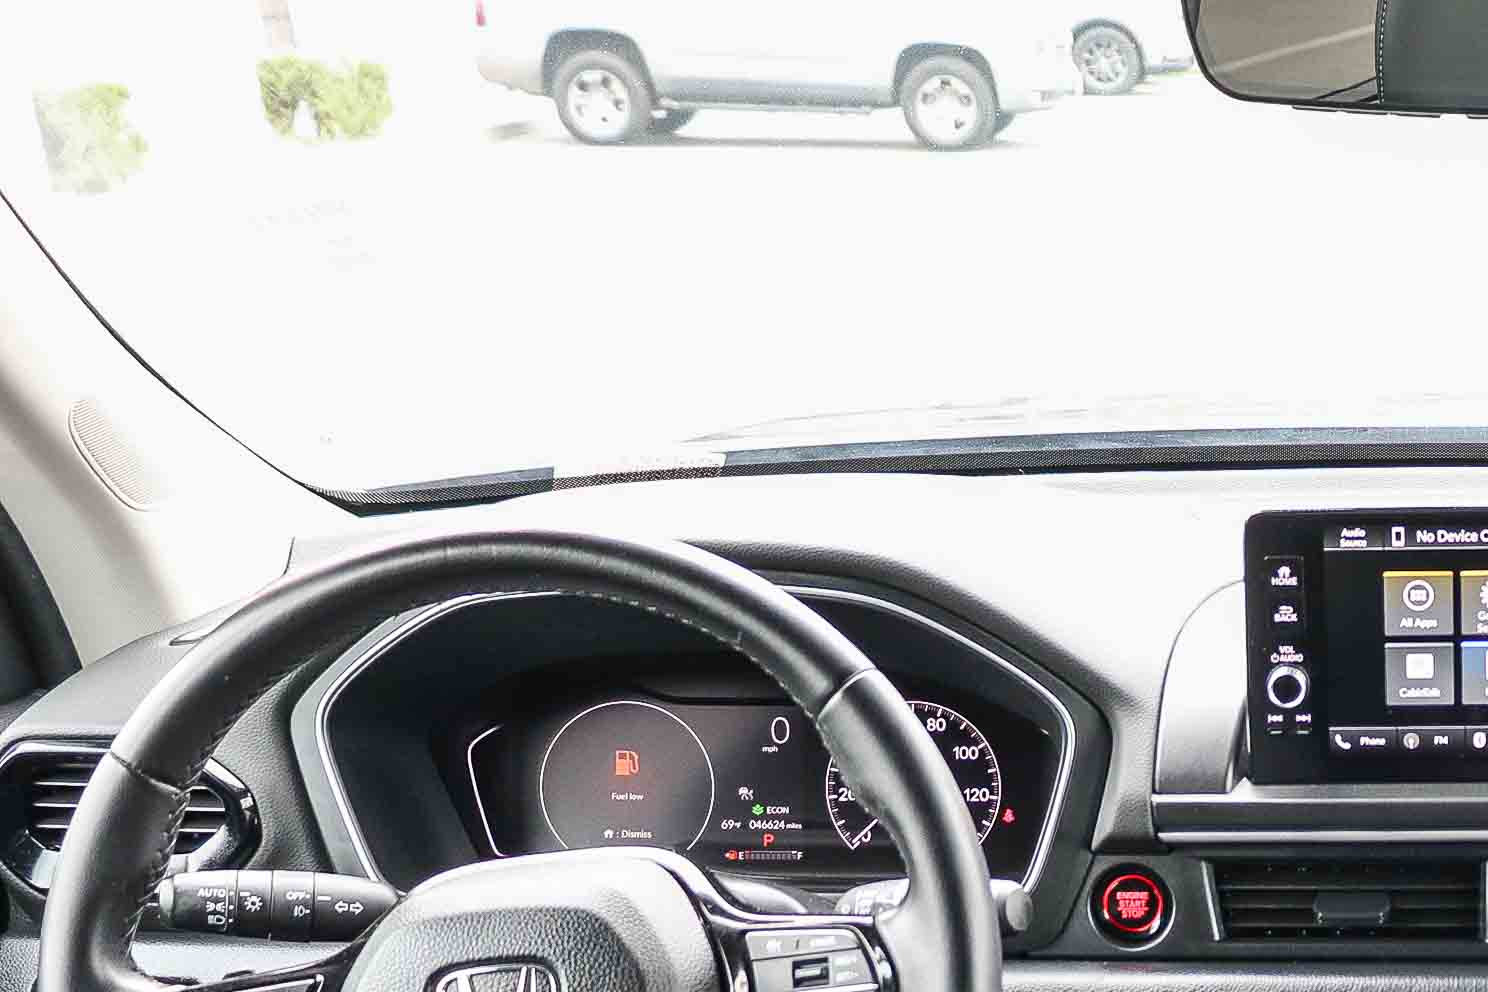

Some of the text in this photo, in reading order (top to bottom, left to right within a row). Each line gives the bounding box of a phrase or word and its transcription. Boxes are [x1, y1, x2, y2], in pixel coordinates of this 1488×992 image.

[1341, 527, 1366, 537] Audio
[1416, 529, 1435, 543] No
[1437, 529, 1478, 543] Device
[1271, 577, 1298, 586] HOME
[1274, 613, 1298, 622] BACK
[1400, 617, 1438, 629] All Apps
[1279, 645, 1295, 653] VOL
[1280, 654, 1304, 662] AUDIO
[926, 717, 947, 732] 80
[771, 716, 791, 745] 0
[1360, 736, 1386, 746] Phone
[1434, 735, 1449, 745] FM
[762, 746, 778, 754] mph
[952, 745, 979, 760] 100
[611, 792, 644, 801] Fuel low
[963, 791, 990, 802] 120
[766, 805, 790, 815] ECON
[749, 818, 786, 830] 046624
[786, 822, 803, 830] miles
[621, 829, 653, 839] Dismiss
[763, 833, 775, 847] P
[738, 853, 745, 861] E
[197, 887, 226, 898] AUTO
[286, 891, 305, 900] OFF
